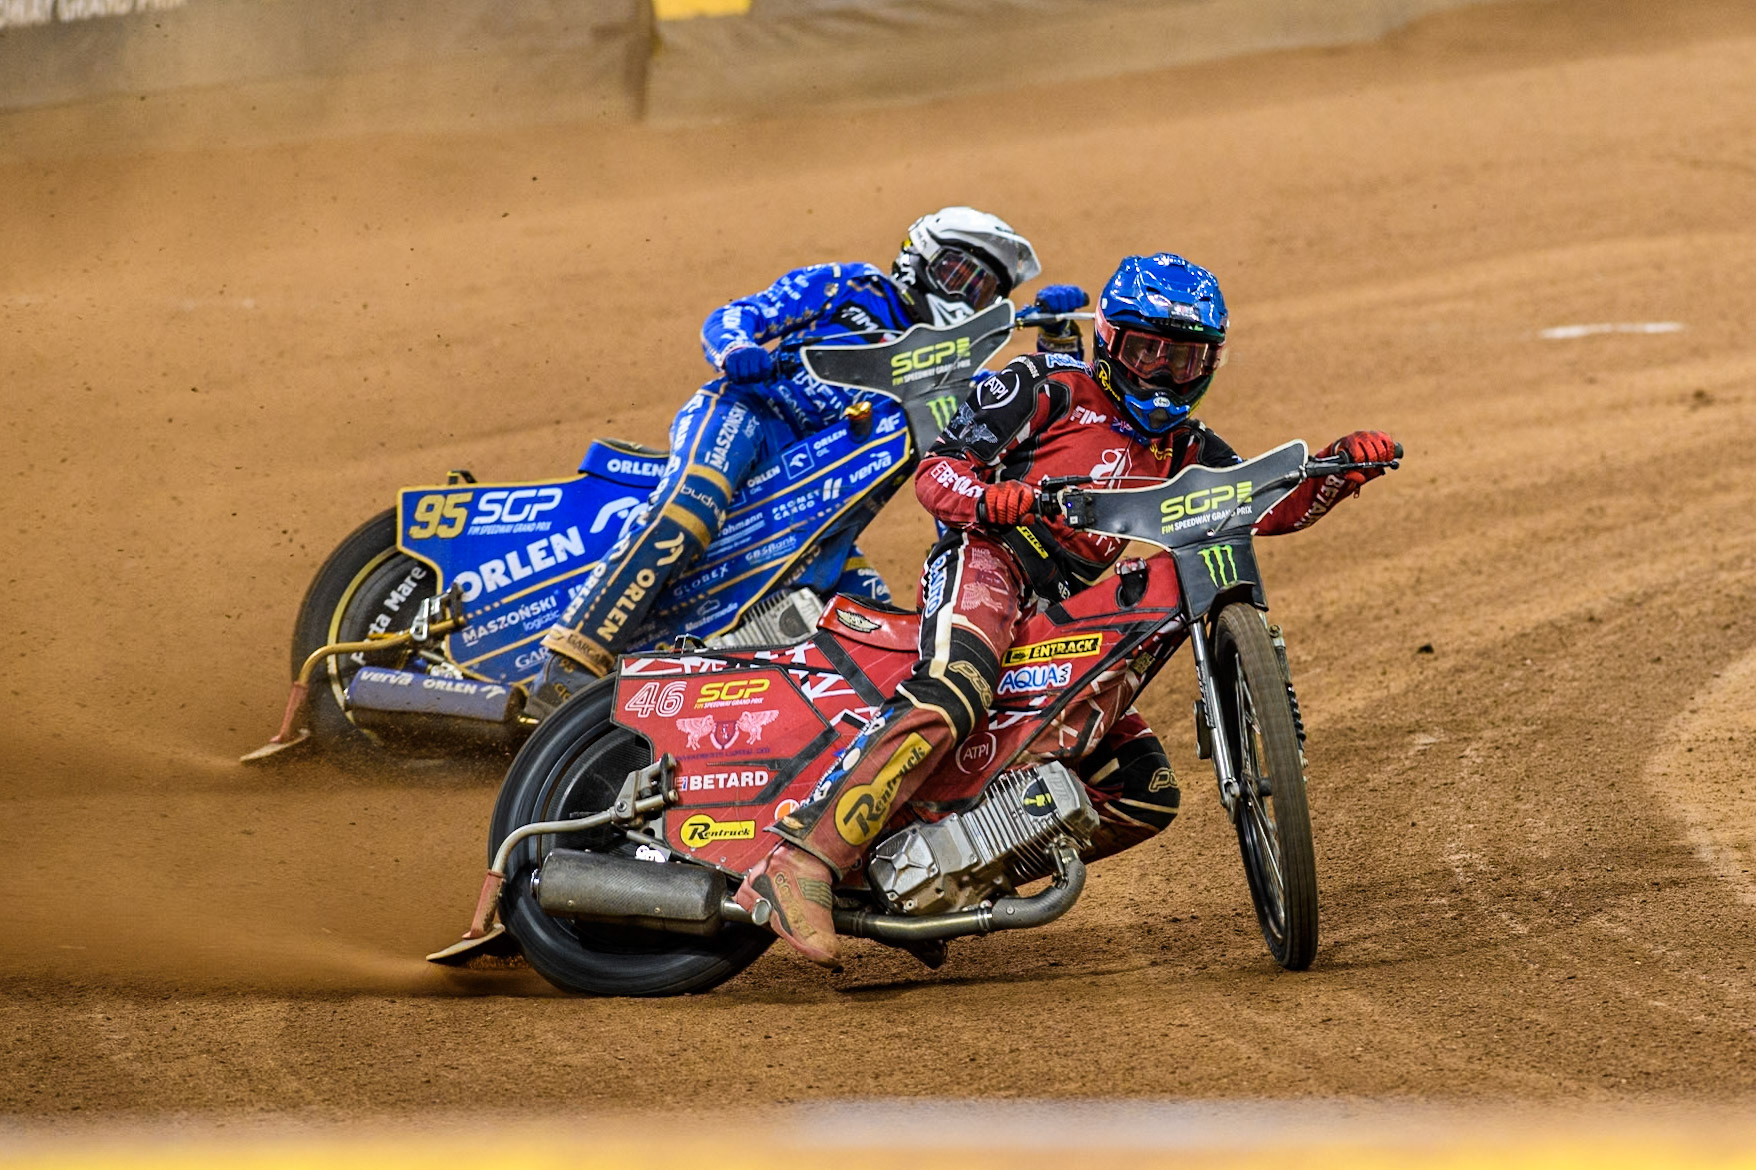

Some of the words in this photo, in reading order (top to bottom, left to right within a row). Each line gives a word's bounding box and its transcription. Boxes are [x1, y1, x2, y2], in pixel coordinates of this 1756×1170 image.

[1069, 405, 1107, 425] FIM
[813, 429, 848, 451] ORLEN
[606, 458, 666, 478] ORLEN
[747, 465, 780, 489] ORLEN
[471, 487, 564, 525] SGP
[772, 489, 821, 515] PROMET
[774, 500, 816, 521] CARGO
[1160, 484, 1236, 524] SGP
[408, 491, 475, 540] 95
[1174, 513, 1212, 532] SPEEDWAY
[1236, 505, 1253, 516] PRIX
[453, 525, 586, 603] ORLEN
[383, 566, 428, 612] Mare
[673, 563, 729, 597] GLOBEX
[596, 567, 656, 642] ORLEN
[461, 595, 558, 646] MASZOŃSKI
[1031, 638, 1094, 660] ENTRACK
[359, 671, 416, 687] verva
[422, 678, 479, 695] ORLEN
[696, 678, 771, 704] SGP
[624, 680, 688, 719] 46
[703, 700, 733, 710] SPEEDWAY
[963, 743, 990, 761] ATPI
[689, 771, 770, 791] BETARD
[842, 746, 927, 838] Rentruck
[688, 822, 751, 841] Rentruck
